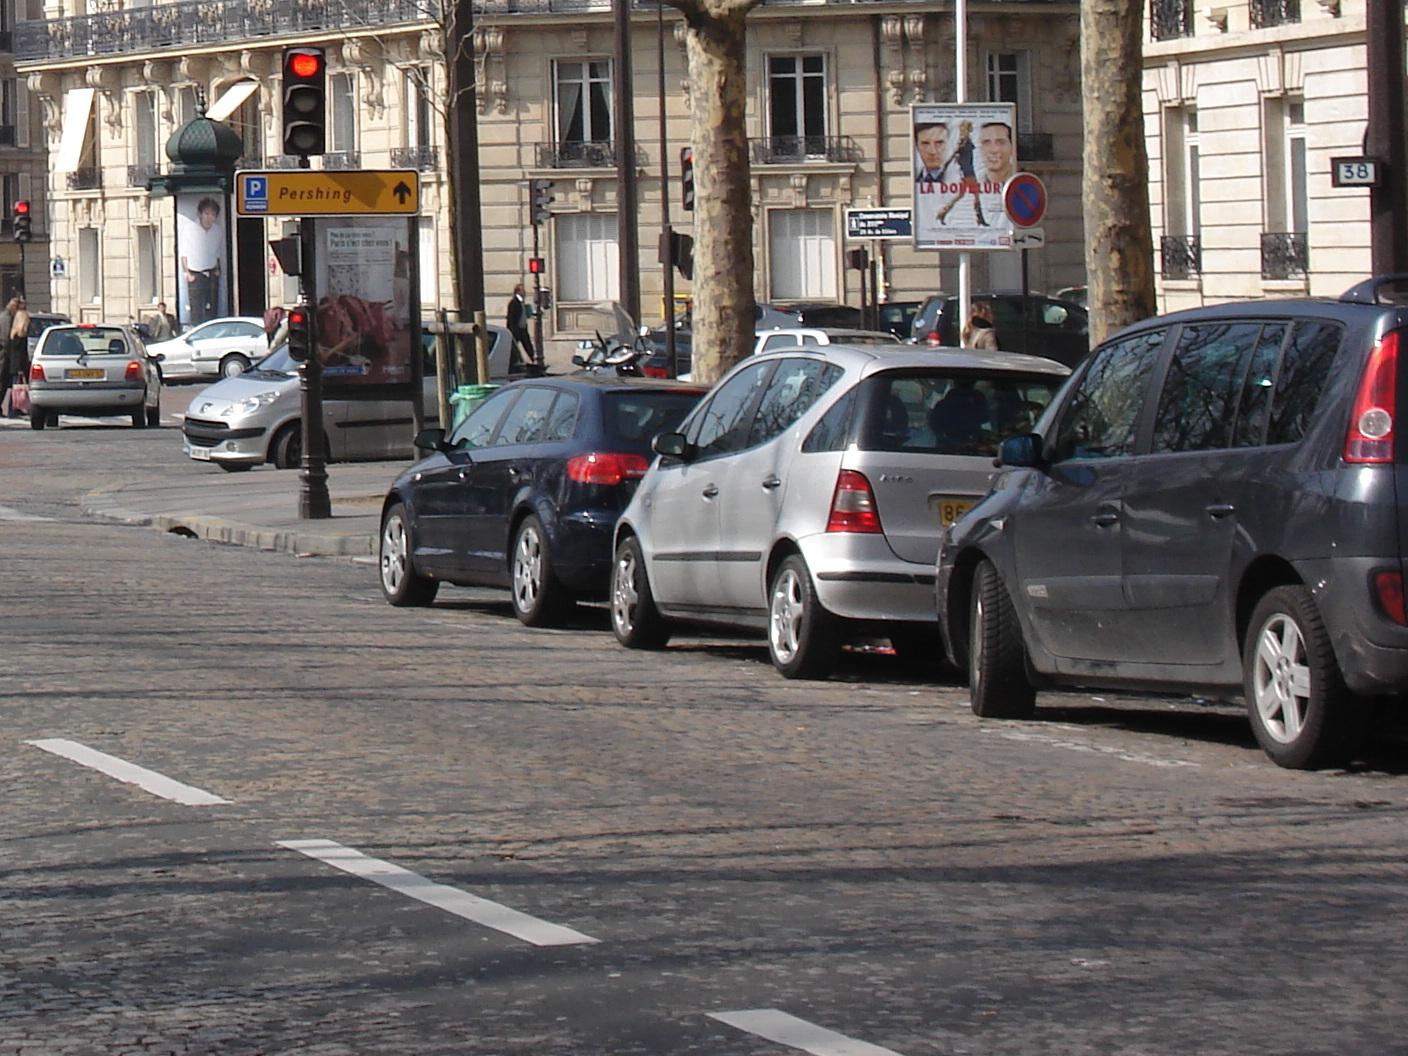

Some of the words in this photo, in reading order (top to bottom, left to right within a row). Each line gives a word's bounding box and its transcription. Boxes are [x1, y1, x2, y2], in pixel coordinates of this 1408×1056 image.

[1344, 163, 1369, 179] 38
[250, 180, 261, 196] P
[279, 187, 352, 204] Pershing
[919, 182, 935, 194] LA
